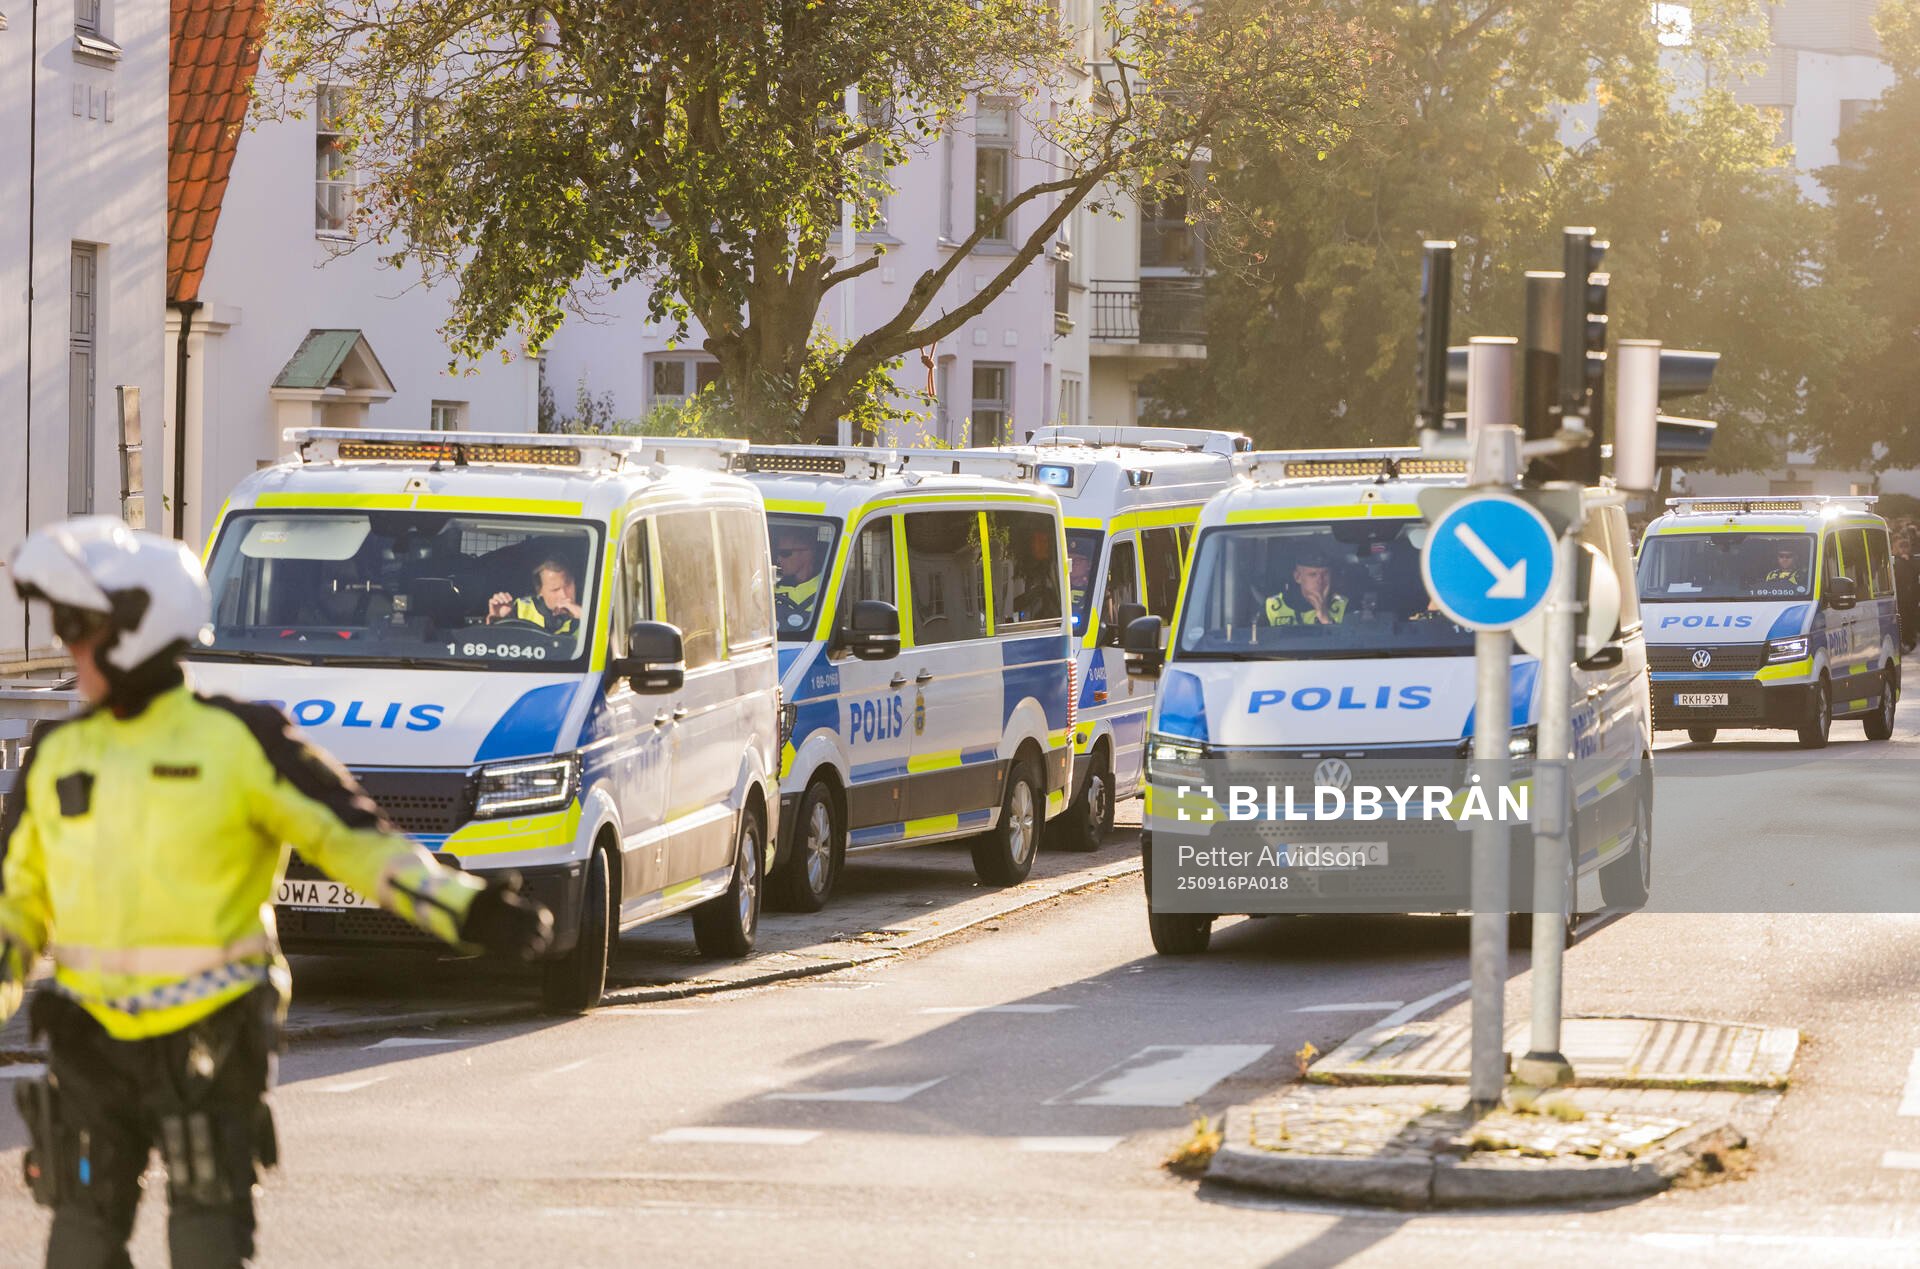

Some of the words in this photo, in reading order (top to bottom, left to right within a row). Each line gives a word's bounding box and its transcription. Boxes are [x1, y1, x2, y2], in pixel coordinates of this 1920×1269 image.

[1660, 615, 1752, 629] POLIS
[447, 642, 456, 656] 1
[462, 642, 546, 660] 69-0340
[1248, 685, 1432, 714] POLIS
[1682, 694, 1702, 704] RKH
[1704, 694, 1724, 704] 93Y
[850, 695, 903, 745] POLIS
